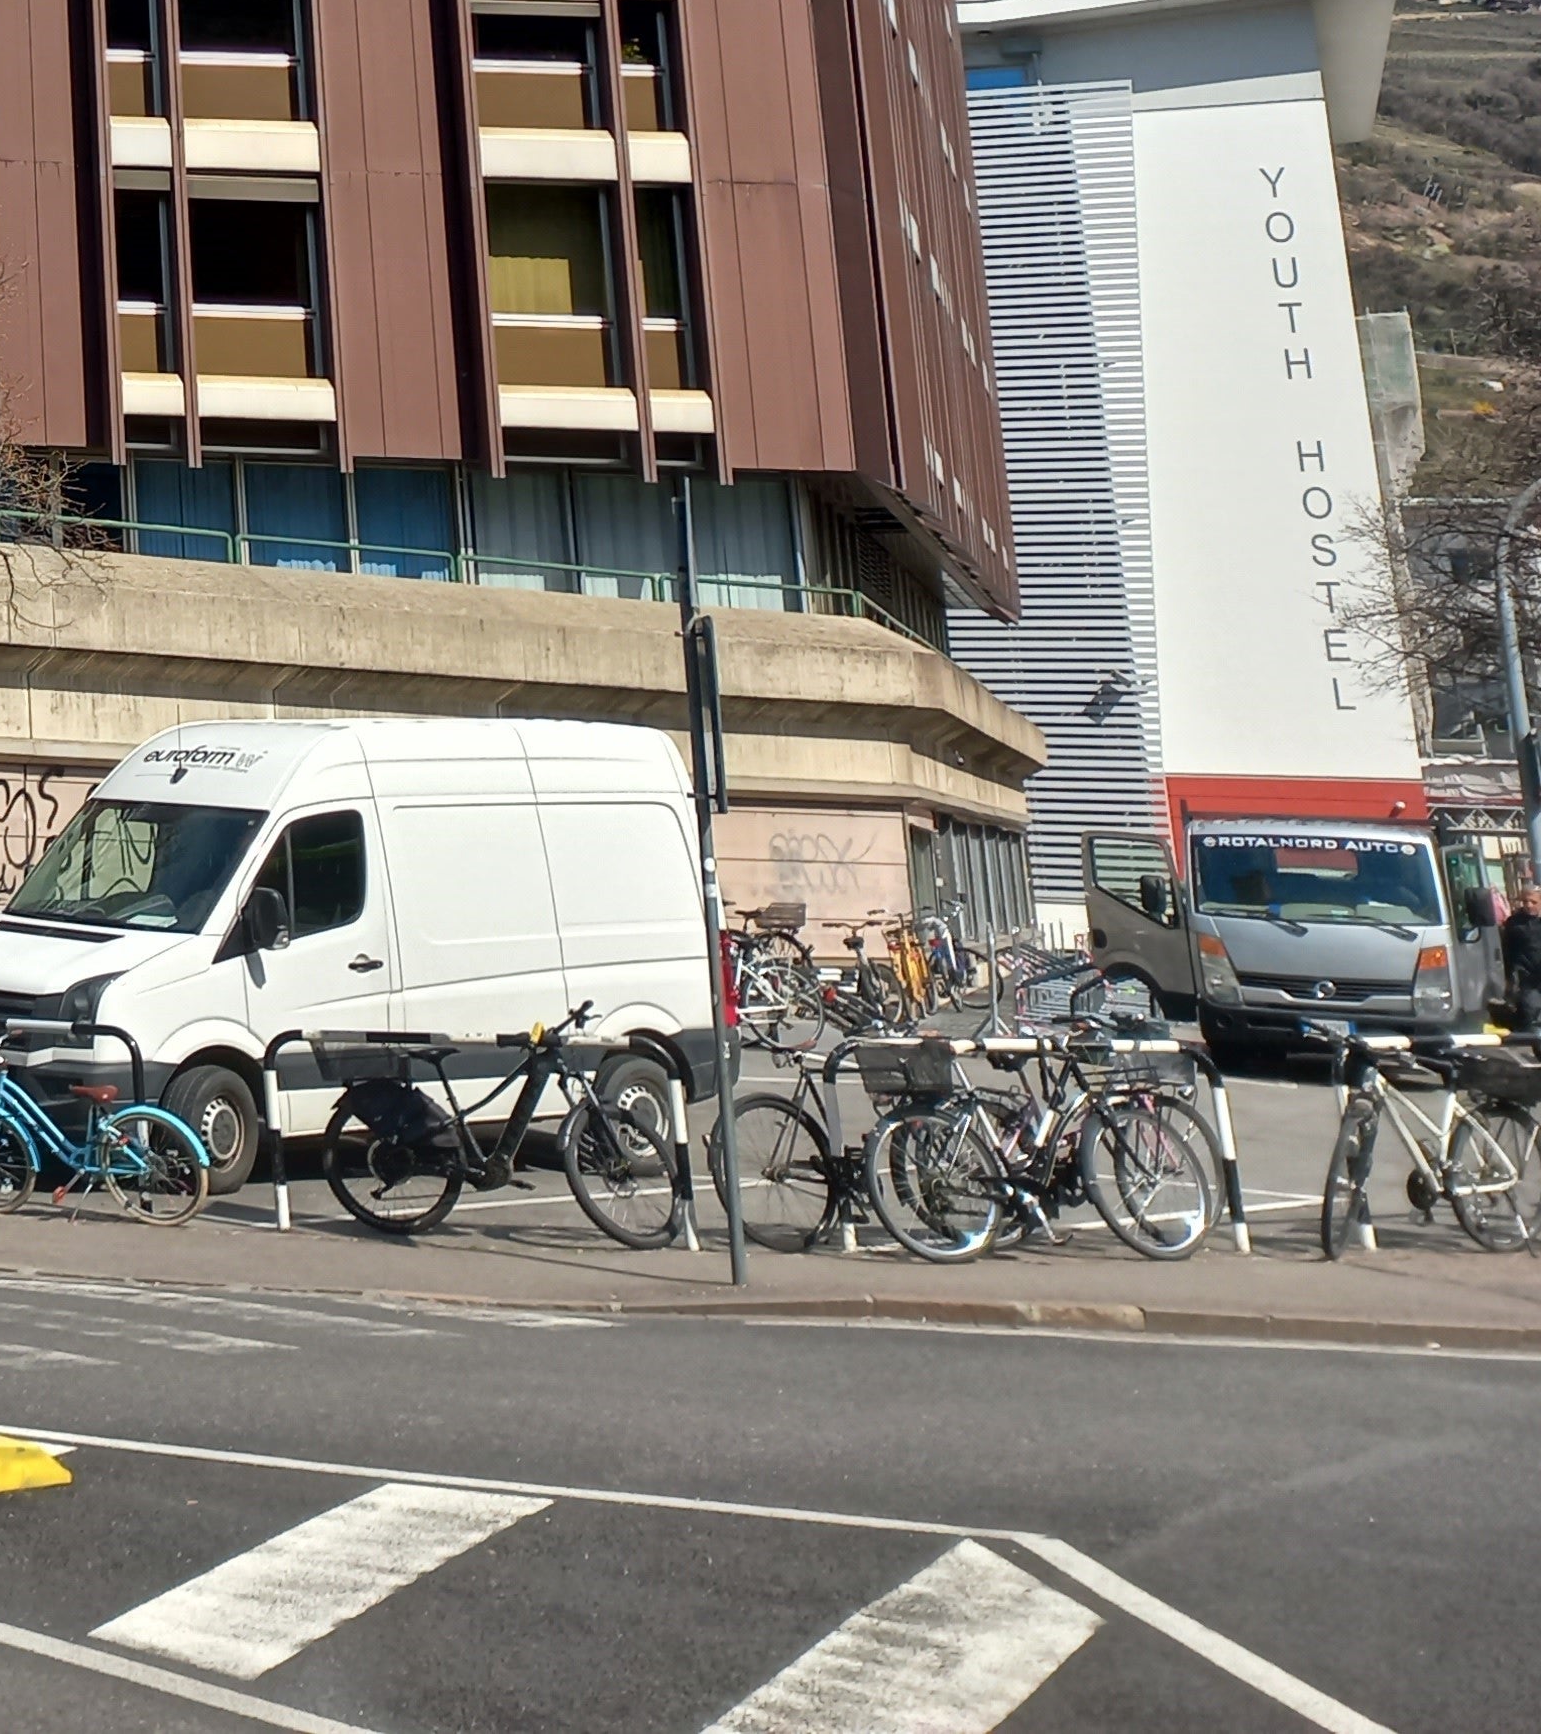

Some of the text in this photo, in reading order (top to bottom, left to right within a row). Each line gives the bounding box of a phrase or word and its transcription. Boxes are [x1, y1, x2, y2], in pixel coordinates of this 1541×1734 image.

[1259, 167, 1357, 711] YOUTH HOSTEL
[143, 745, 235, 765] euroform
[1218, 836, 1400, 854] ROTALNORD AUTO
